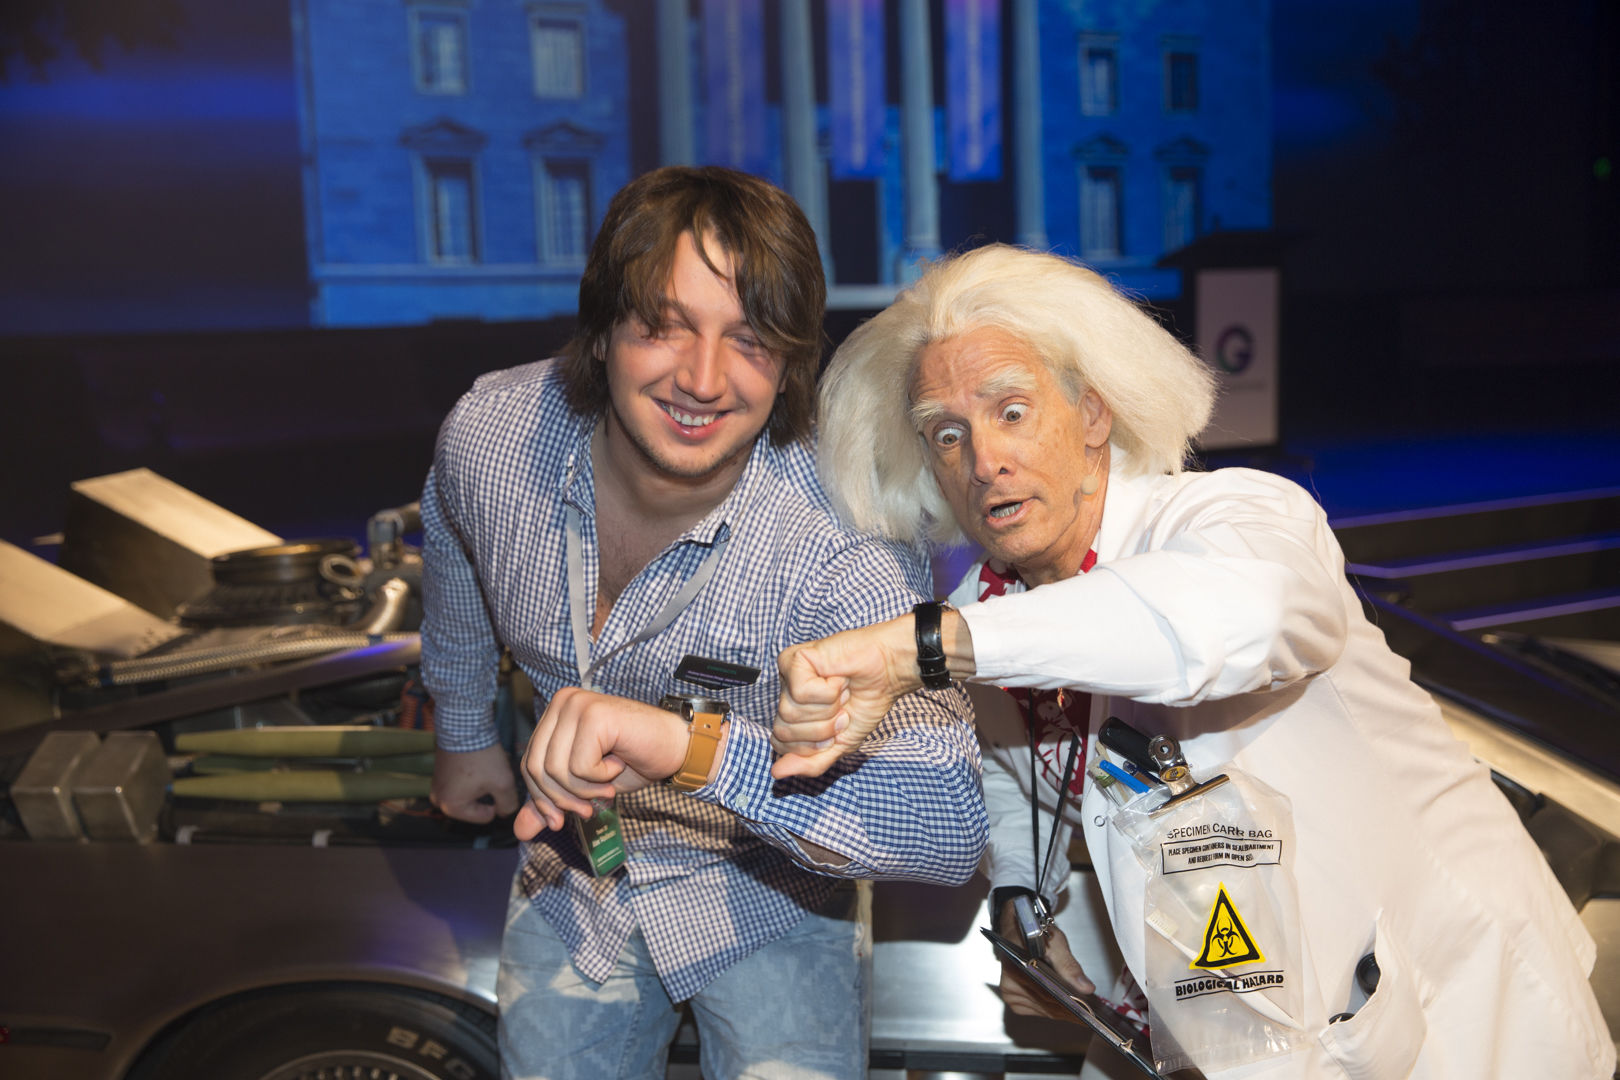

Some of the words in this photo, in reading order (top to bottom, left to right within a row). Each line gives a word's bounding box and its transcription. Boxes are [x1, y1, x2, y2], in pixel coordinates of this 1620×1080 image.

[1216, 325, 1254, 374] G
[1167, 824, 1211, 839] SPECIMEN
[1248, 829, 1273, 839] BAG
[1168, 847, 1181, 857] PLACE
[1182, 845, 1202, 855] SPECIMEN
[1231, 853, 1245, 862] OPEN
[1175, 978, 1240, 996] BIOLOGICAL
[1242, 974, 1284, 989] HAZARD
